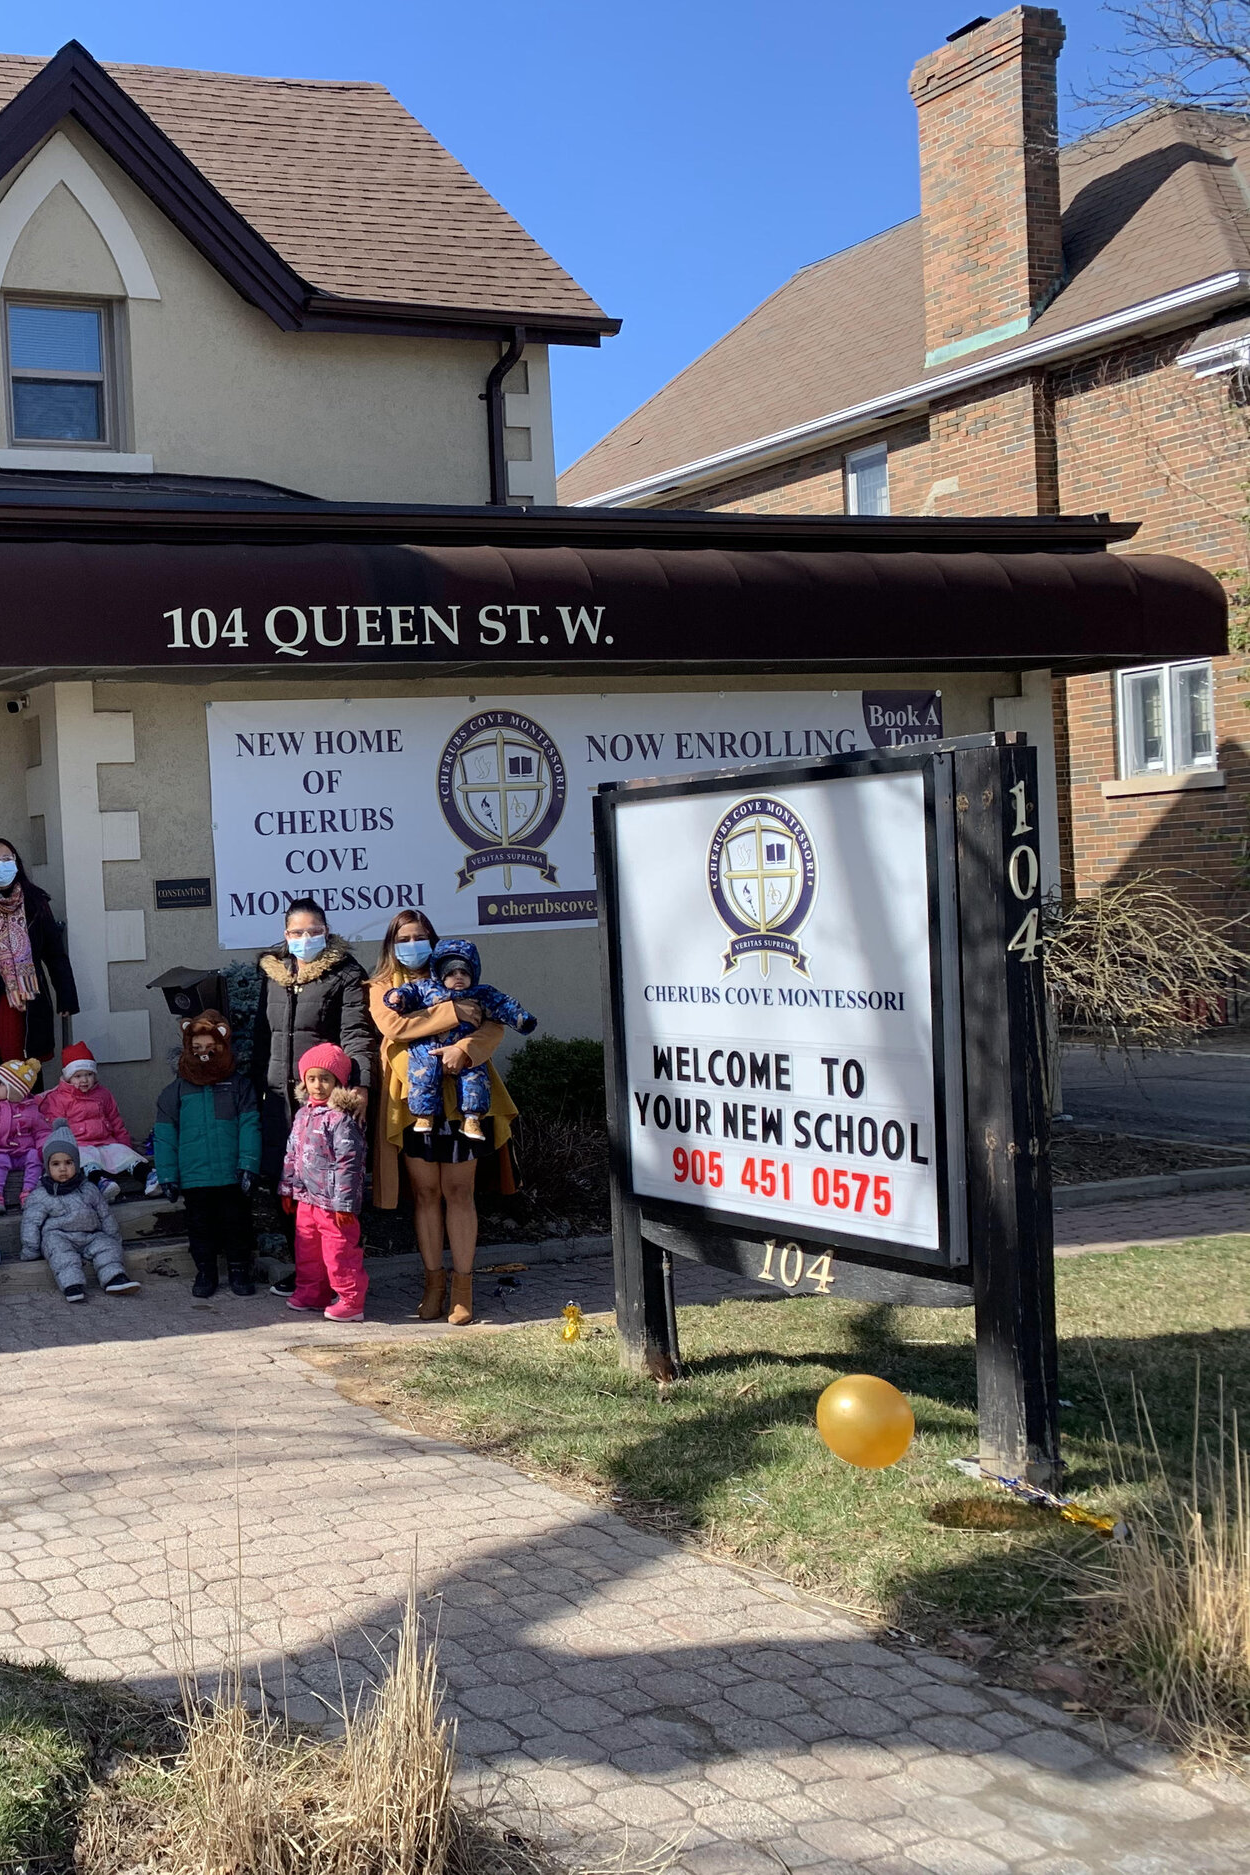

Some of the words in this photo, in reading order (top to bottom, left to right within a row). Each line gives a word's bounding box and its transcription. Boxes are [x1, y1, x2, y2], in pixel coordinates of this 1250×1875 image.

[163, 607, 249, 649] 104
[264, 604, 462, 657] QUEEN
[868, 705, 921, 727] Book
[925, 705, 941, 725] A
[235, 731, 305, 757] NEW
[313, 729, 404, 755] HOME
[441, 730, 467, 795] CHERUBS
[469, 713, 504, 731] COVE
[510, 715, 565, 791] MONTESSORI
[585, 732, 665, 763] NOW
[674, 728, 857, 760] ENROLLING
[302, 769, 342, 794] OF
[254, 806, 394, 836] CHERUBS
[471, 853, 504, 866] VERITAS
[506, 852, 543, 864] SUPREMA
[710, 818, 732, 882] CHERUBS
[733, 801, 762, 819] COVE
[766, 802, 815, 877] MONTESSORI
[285, 847, 368, 874] COVE
[1007, 780, 1043, 963] 104
[735, 939, 762, 950] VERITAS
[764, 939, 795, 952] SUPREMA
[644, 985, 720, 1004] CHERUBS
[725, 987, 773, 1006] COVE
[778, 989, 905, 1011] MONTESSORI
[653, 1045, 791, 1092] WELCOME
[820, 1057, 865, 1099] TO
[635, 1092, 713, 1136] YOUR
[723, 1102, 783, 1146] NEW
[794, 1110, 929, 1165] SCHOOL
[673, 1147, 723, 1187] 905
[741, 1157, 791, 1201] 451
[812, 1167, 892, 1217] 0575
[758, 1239, 836, 1294] 104
